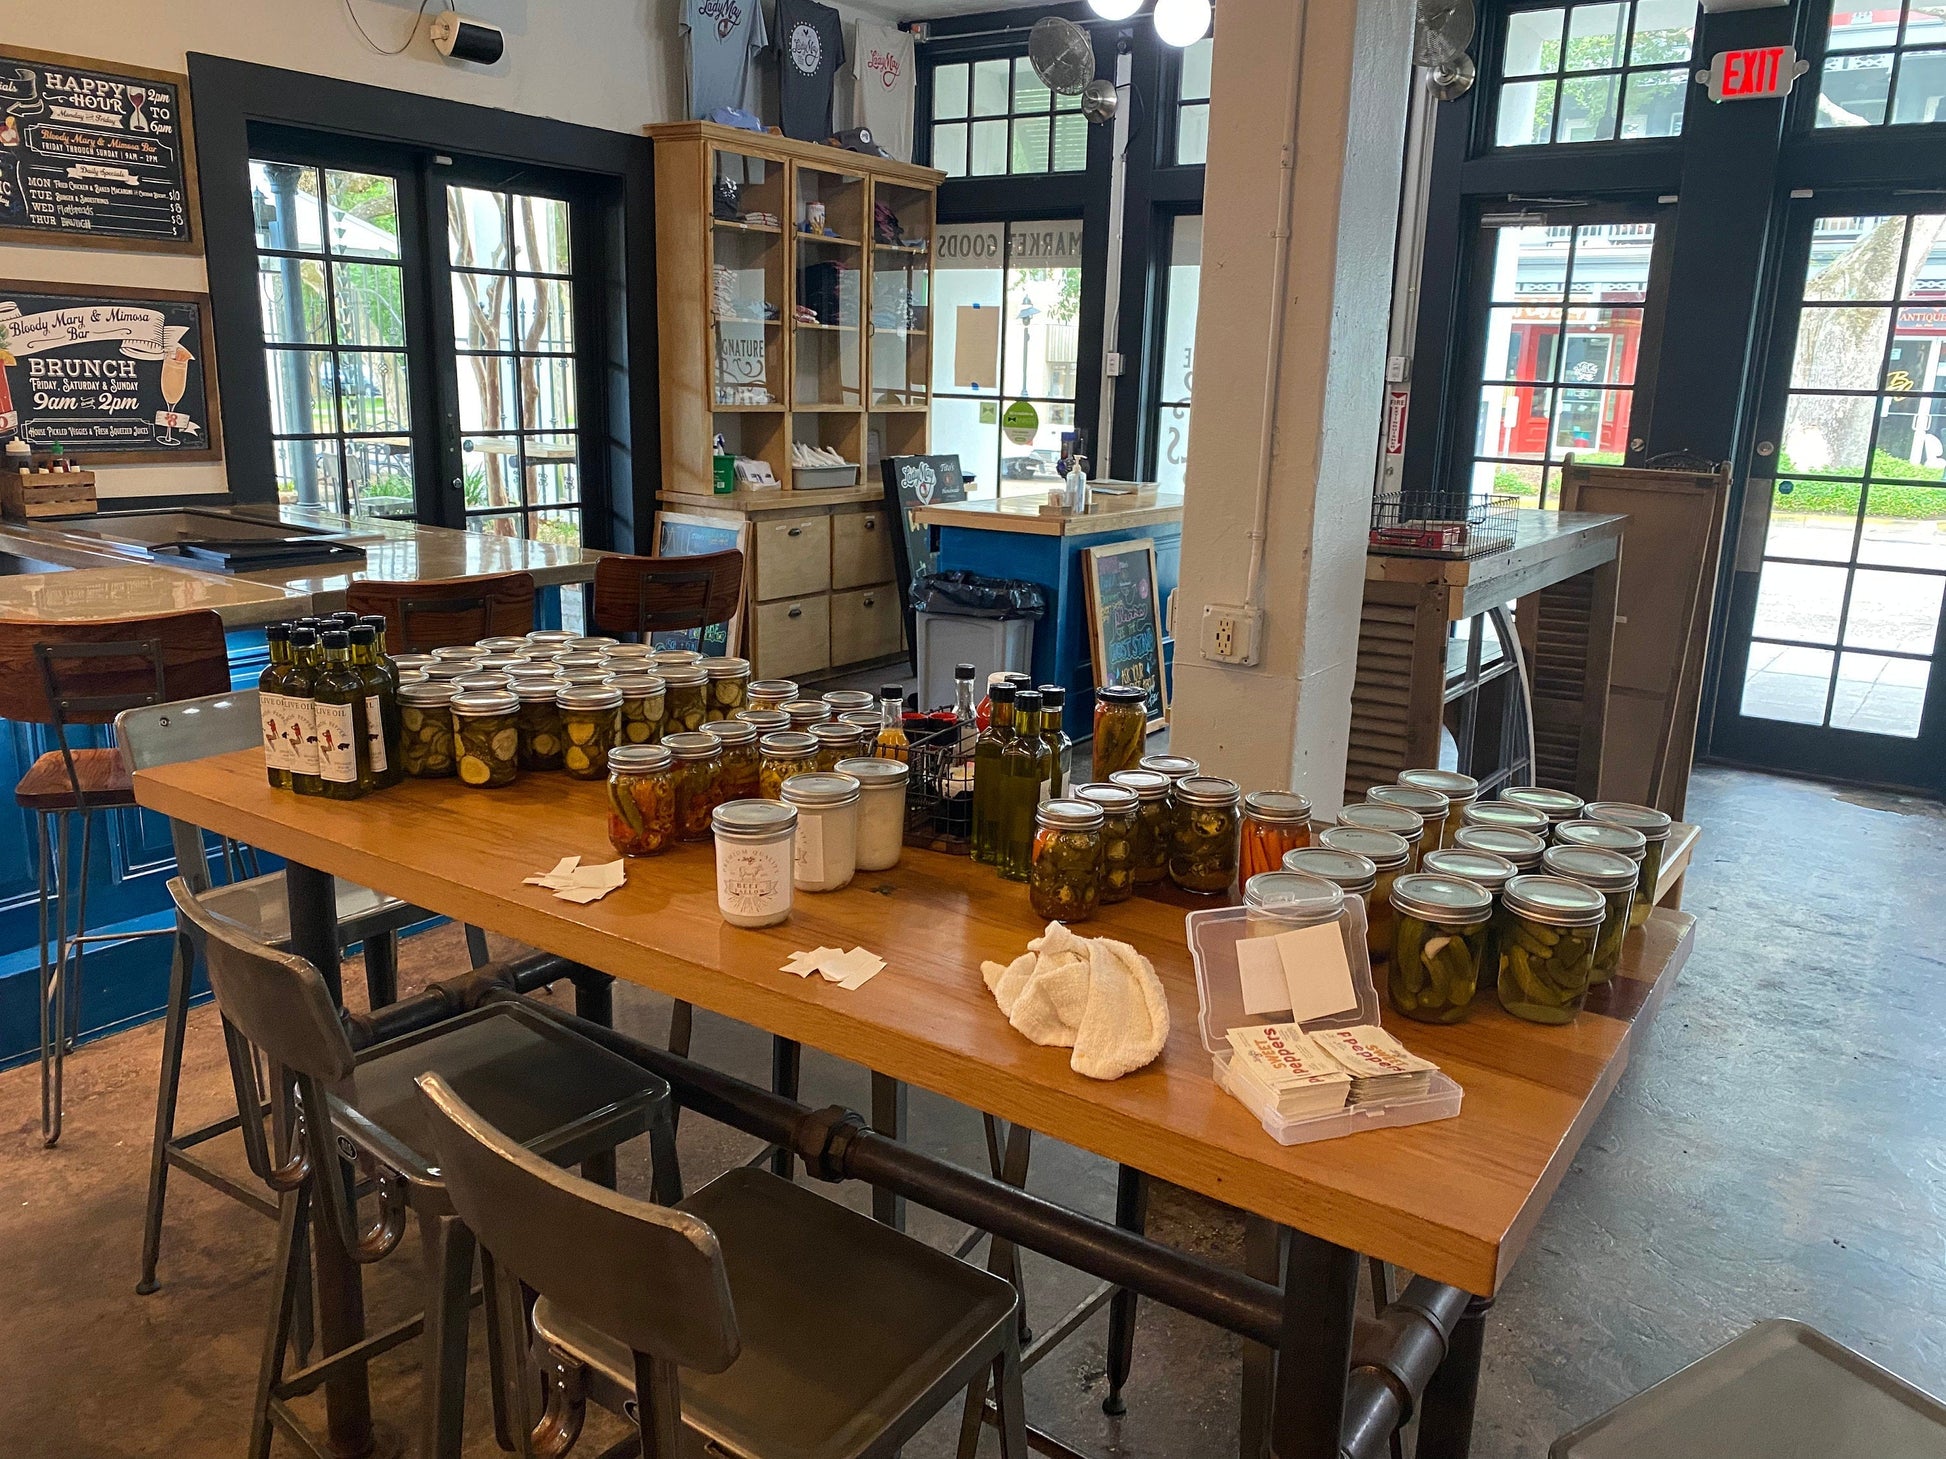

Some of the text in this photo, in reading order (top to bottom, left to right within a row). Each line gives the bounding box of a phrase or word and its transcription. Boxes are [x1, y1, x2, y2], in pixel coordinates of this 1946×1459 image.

[1721, 48, 1784, 96] EXIT
[44, 72, 125, 99] HAPPY
[69, 93, 127, 114] HOUR
[147, 89, 171, 103] 2pm
[149, 106, 170, 119] TO
[150, 121, 173, 134] 6pm
[41, 129, 70, 146] Bloody
[71, 134, 96, 148] Mary
[141, 142, 158, 152] Bar
[42, 142, 63, 151] FRIDAY
[66, 144, 94, 155] THROUGH
[96, 148, 119, 158] SUNDAY
[27, 176, 51, 188] MON
[29, 189, 53, 200] TUE
[31, 202, 54, 213] WED
[29, 214, 57, 225] THUR
[8, 308, 150, 337] Bloody Mary & Mimosa
[67, 327, 90, 341] Bar
[722, 339, 764, 358] GNATURE
[28, 358, 137, 378] BRUNCH
[62, 379, 100, 393] SATURDAY
[110, 379, 138, 393] SUNDAY
[33, 392, 79, 411] 9am
[98, 392, 139, 415] 2pm
[317, 707, 347, 717] LIVE OIL
[1254, 1039, 1287, 1070] SWEET
